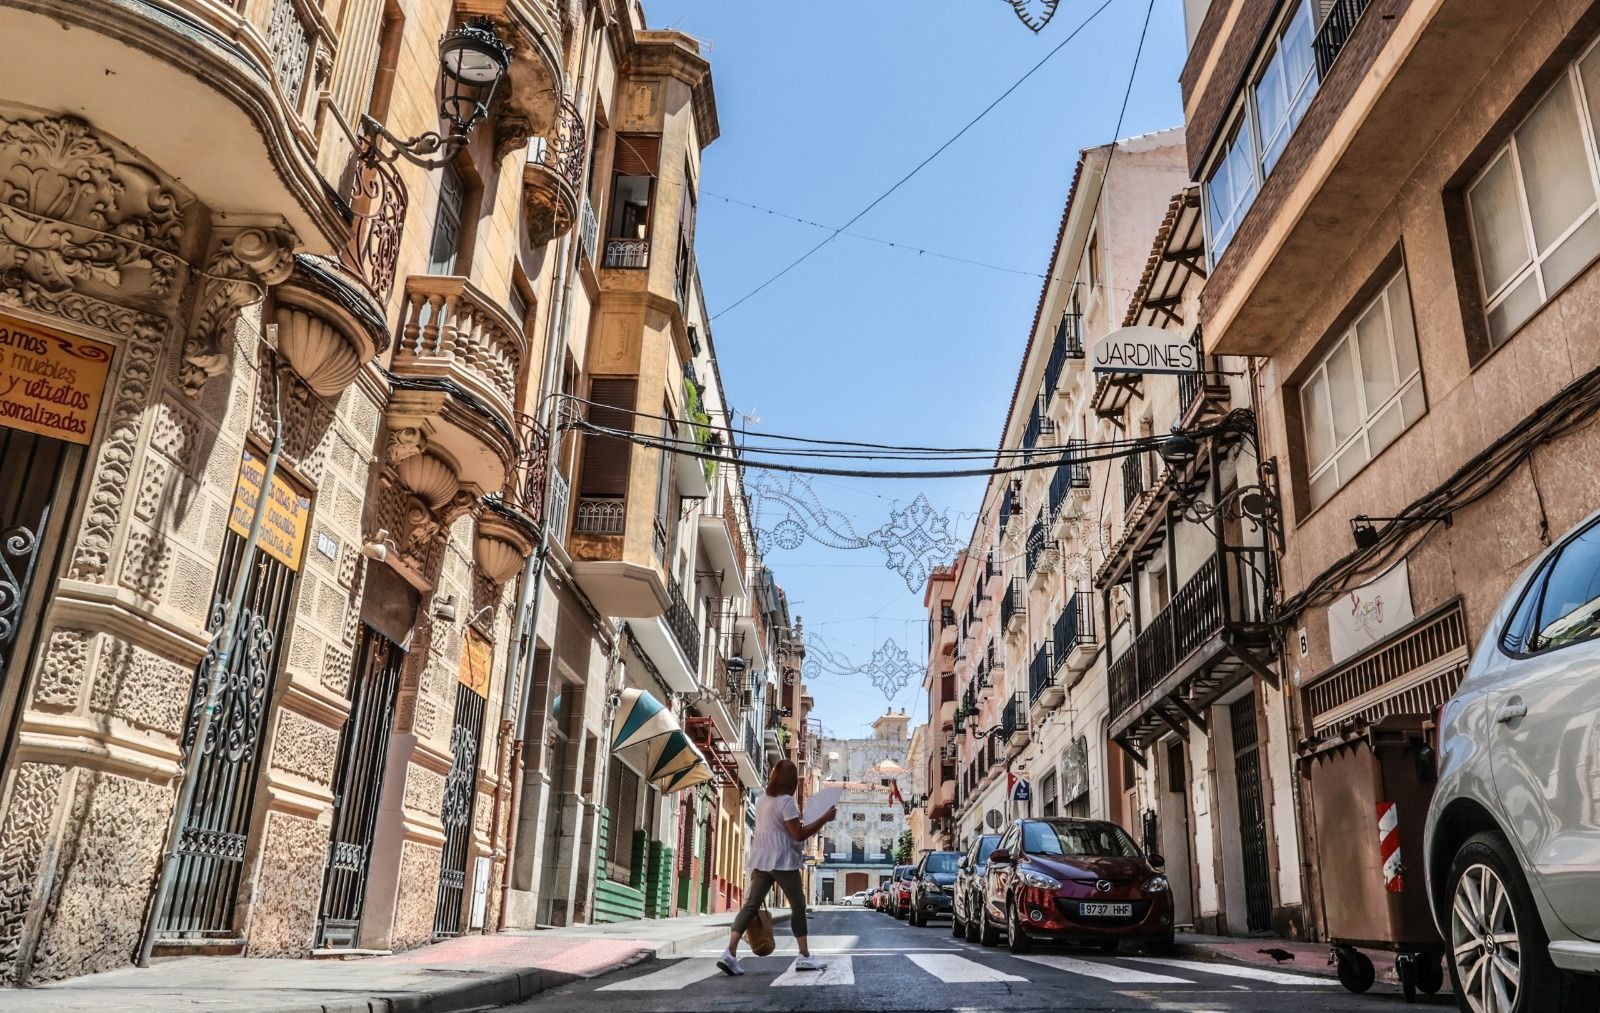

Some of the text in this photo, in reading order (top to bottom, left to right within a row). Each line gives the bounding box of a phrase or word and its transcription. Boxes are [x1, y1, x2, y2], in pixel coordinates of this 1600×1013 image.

[11, 352, 76, 384] muebles
[1097, 342, 1192, 368] JARDINES
[23, 378, 90, 410] retratos
[1300, 636, 1307, 654] B
[1086, 904, 1108, 914] 9737
